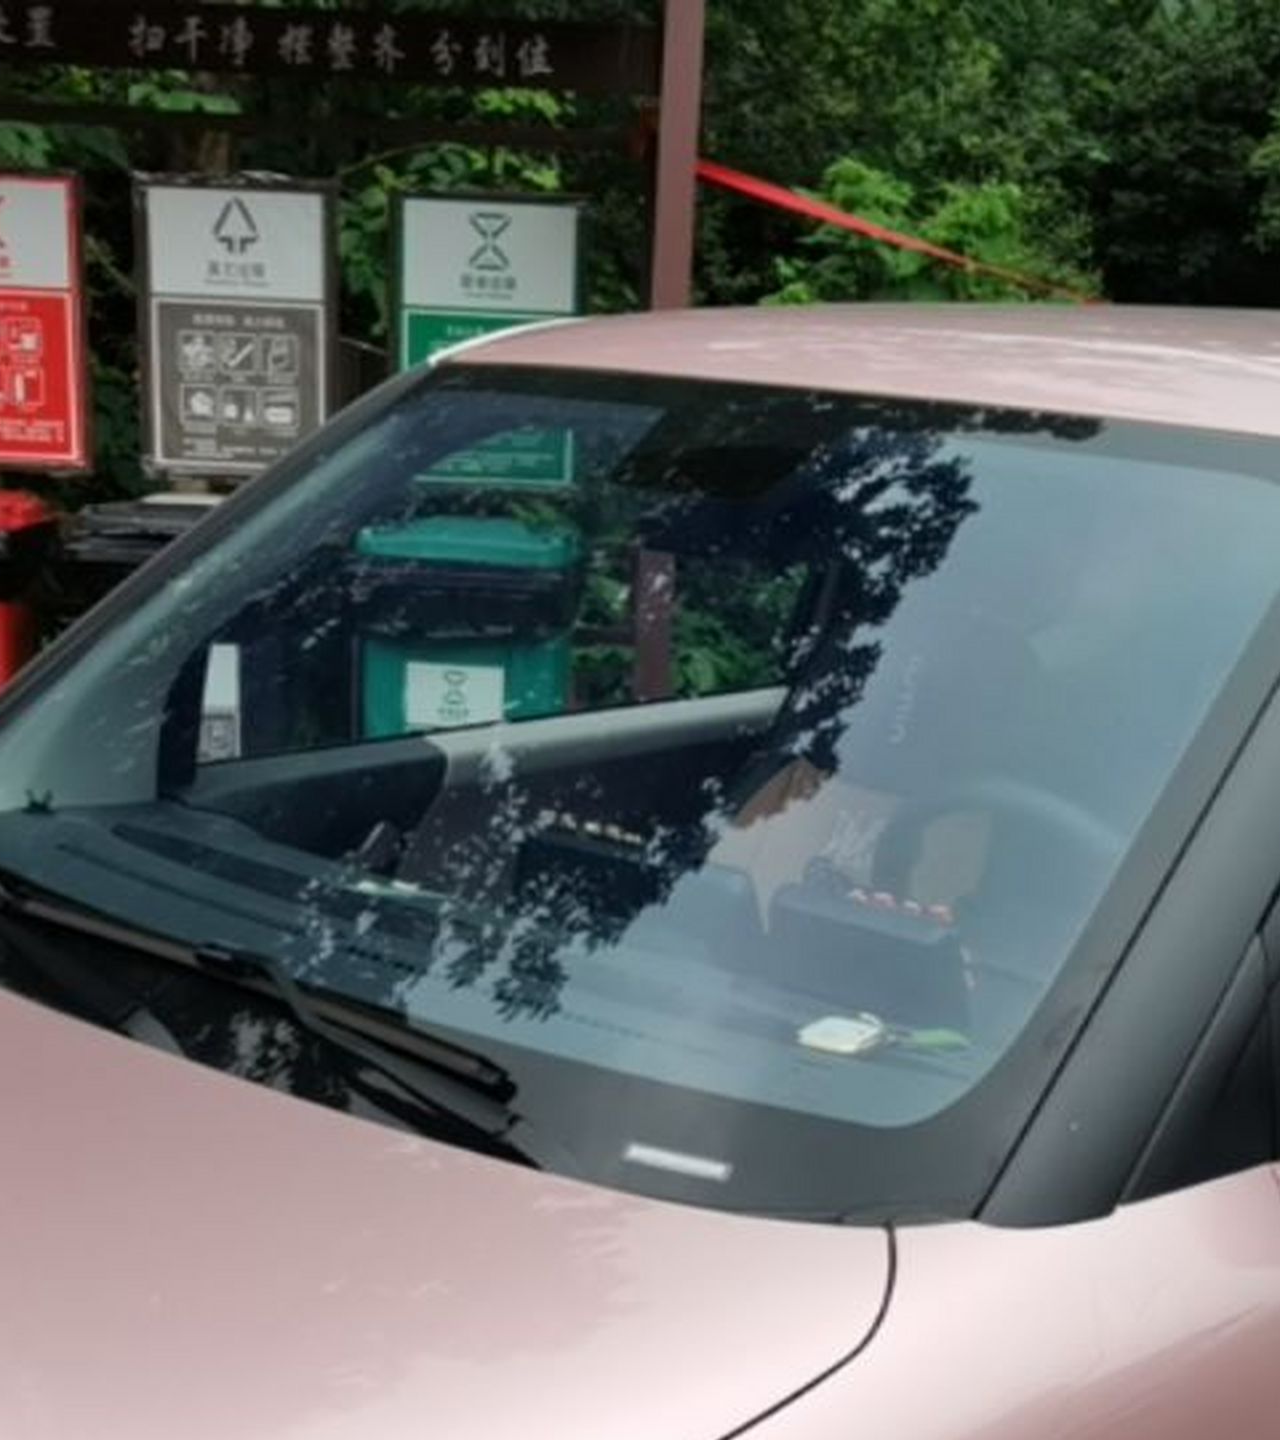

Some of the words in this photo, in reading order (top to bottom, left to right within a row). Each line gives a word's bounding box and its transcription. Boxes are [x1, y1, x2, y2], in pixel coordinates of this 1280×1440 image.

[128, 15, 255, 66] 扫干净
[430, 29, 555, 77] 分到位
